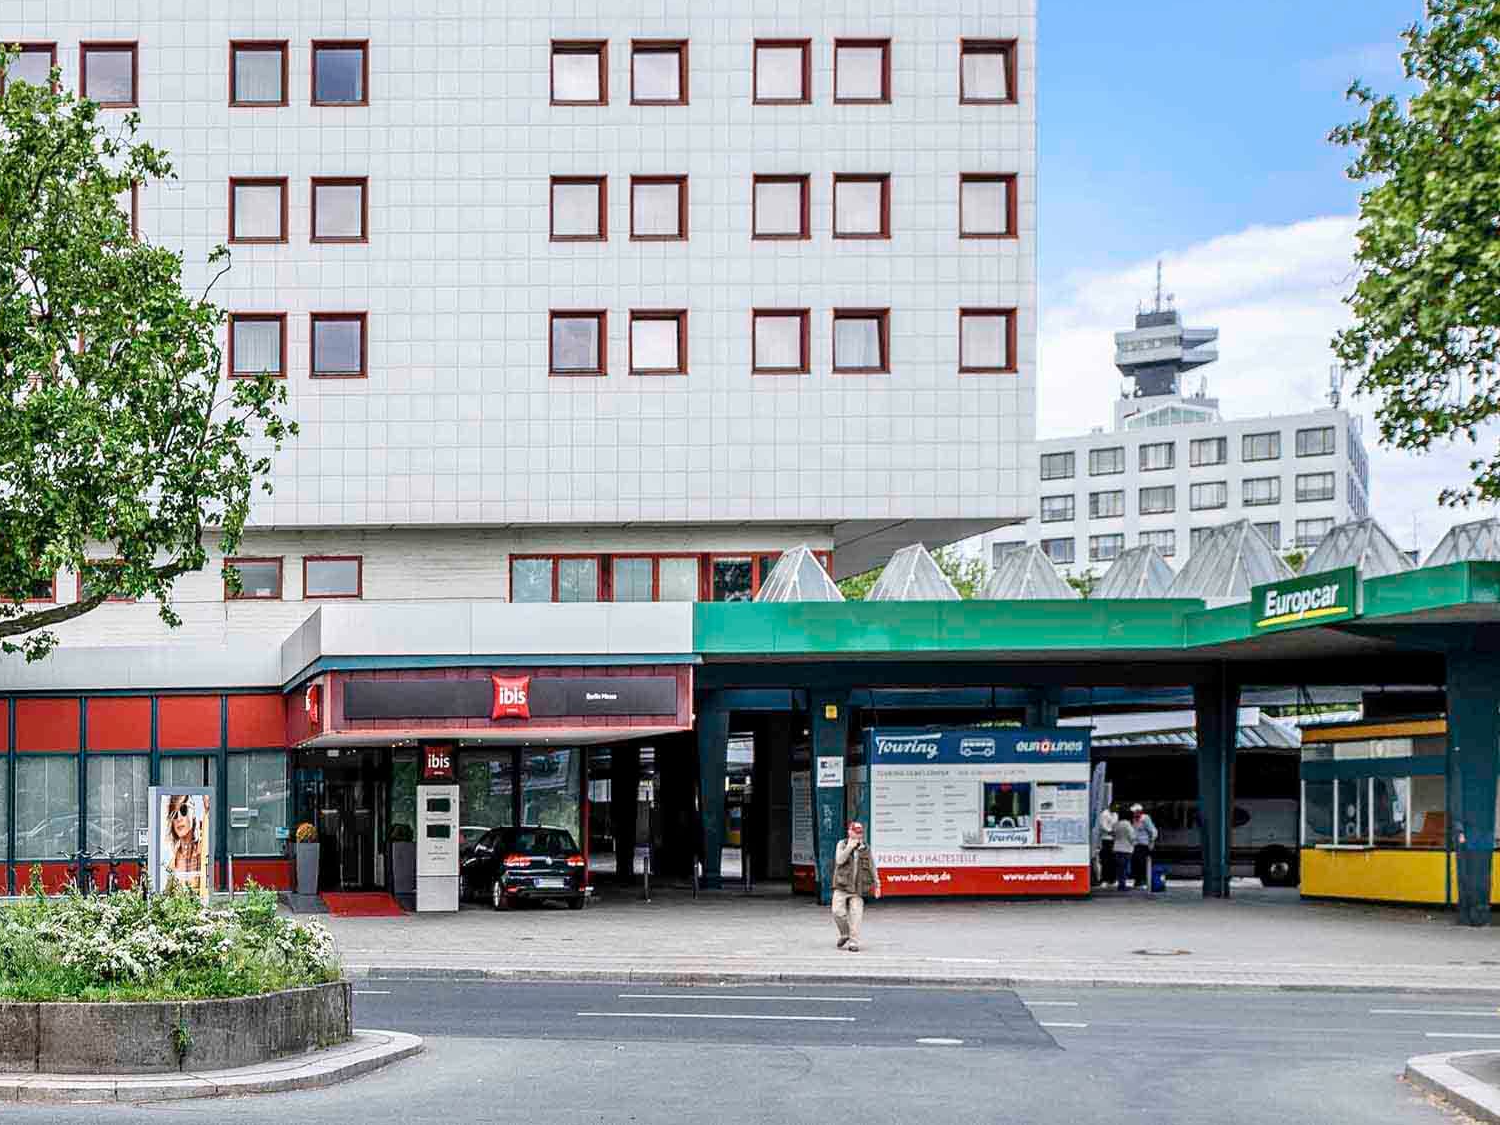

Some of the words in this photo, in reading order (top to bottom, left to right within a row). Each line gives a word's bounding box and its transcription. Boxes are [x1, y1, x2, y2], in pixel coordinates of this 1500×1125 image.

[1263, 582, 1341, 619] Europcar
[499, 686, 526, 704] ibis
[876, 733, 942, 759] Touring
[427, 753, 451, 768] ibis
[887, 871, 951, 884] www.touring.de
